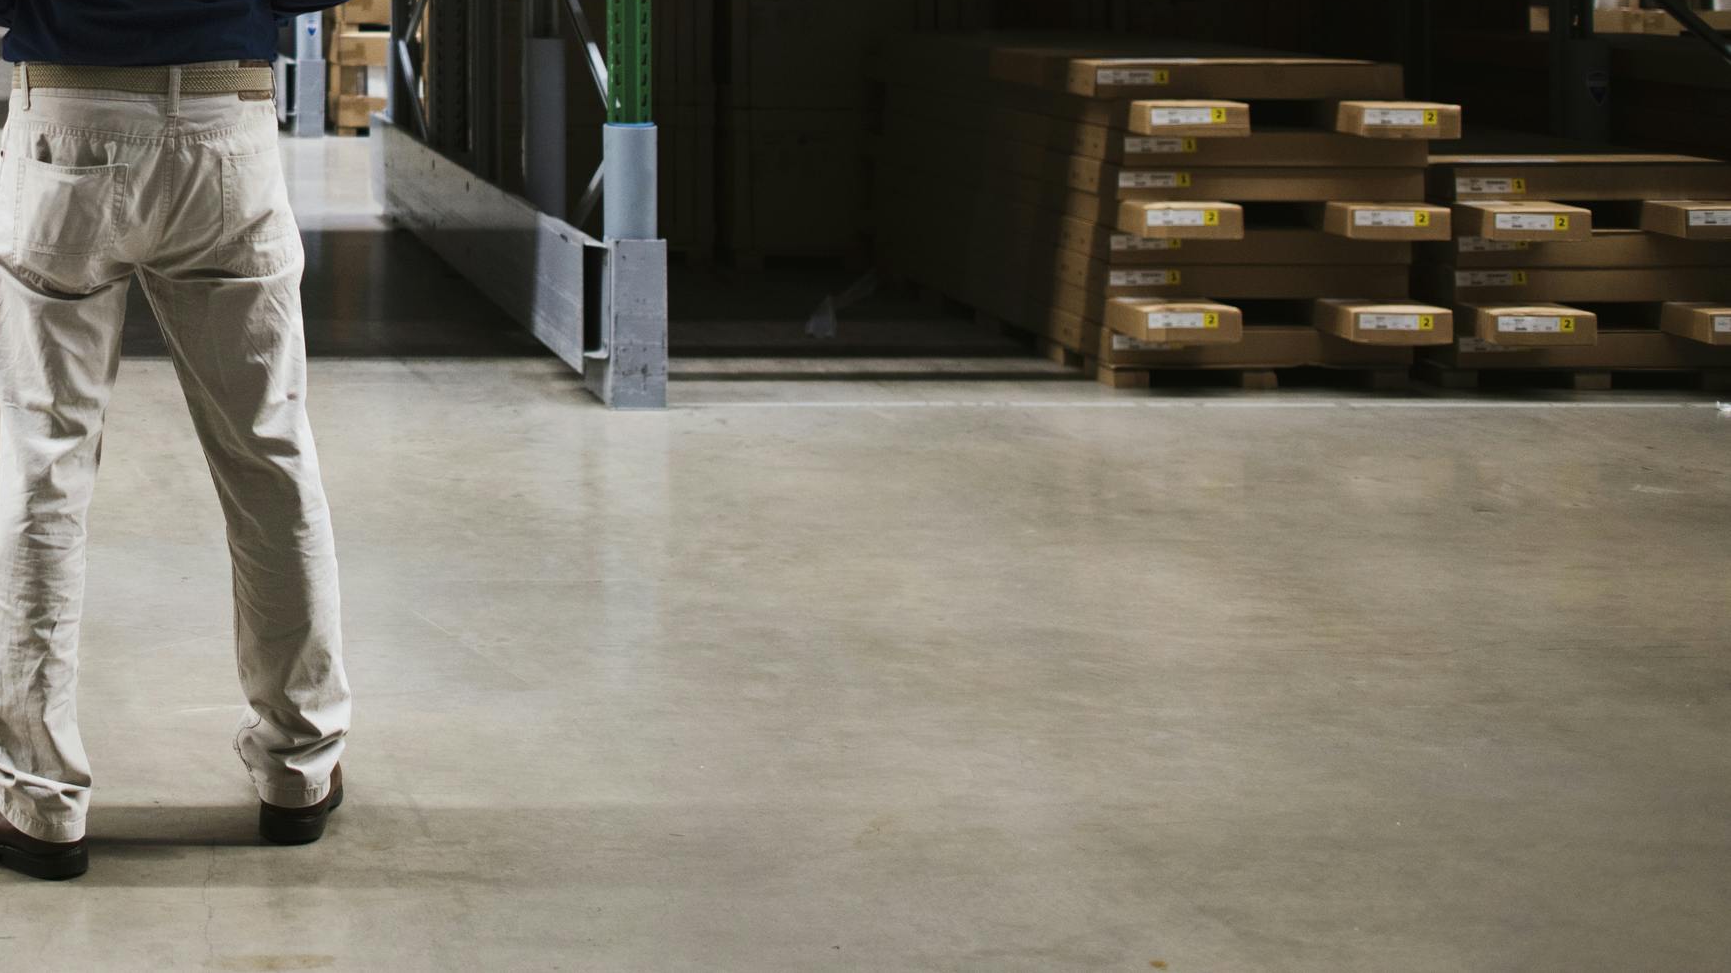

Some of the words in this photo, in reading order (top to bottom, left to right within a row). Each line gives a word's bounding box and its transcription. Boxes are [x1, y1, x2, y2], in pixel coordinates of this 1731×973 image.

[1216, 109, 1222, 119] 2
[1428, 112, 1434, 122] 2
[1517, 180, 1522, 189] 1
[1208, 212, 1215, 222] 2
[1419, 214, 1426, 223] 2
[1559, 217, 1565, 227] 2
[1518, 273, 1523, 282] 1
[1208, 314, 1215, 325] 2
[1424, 317, 1430, 327] 2
[1564, 319, 1571, 329] 2
